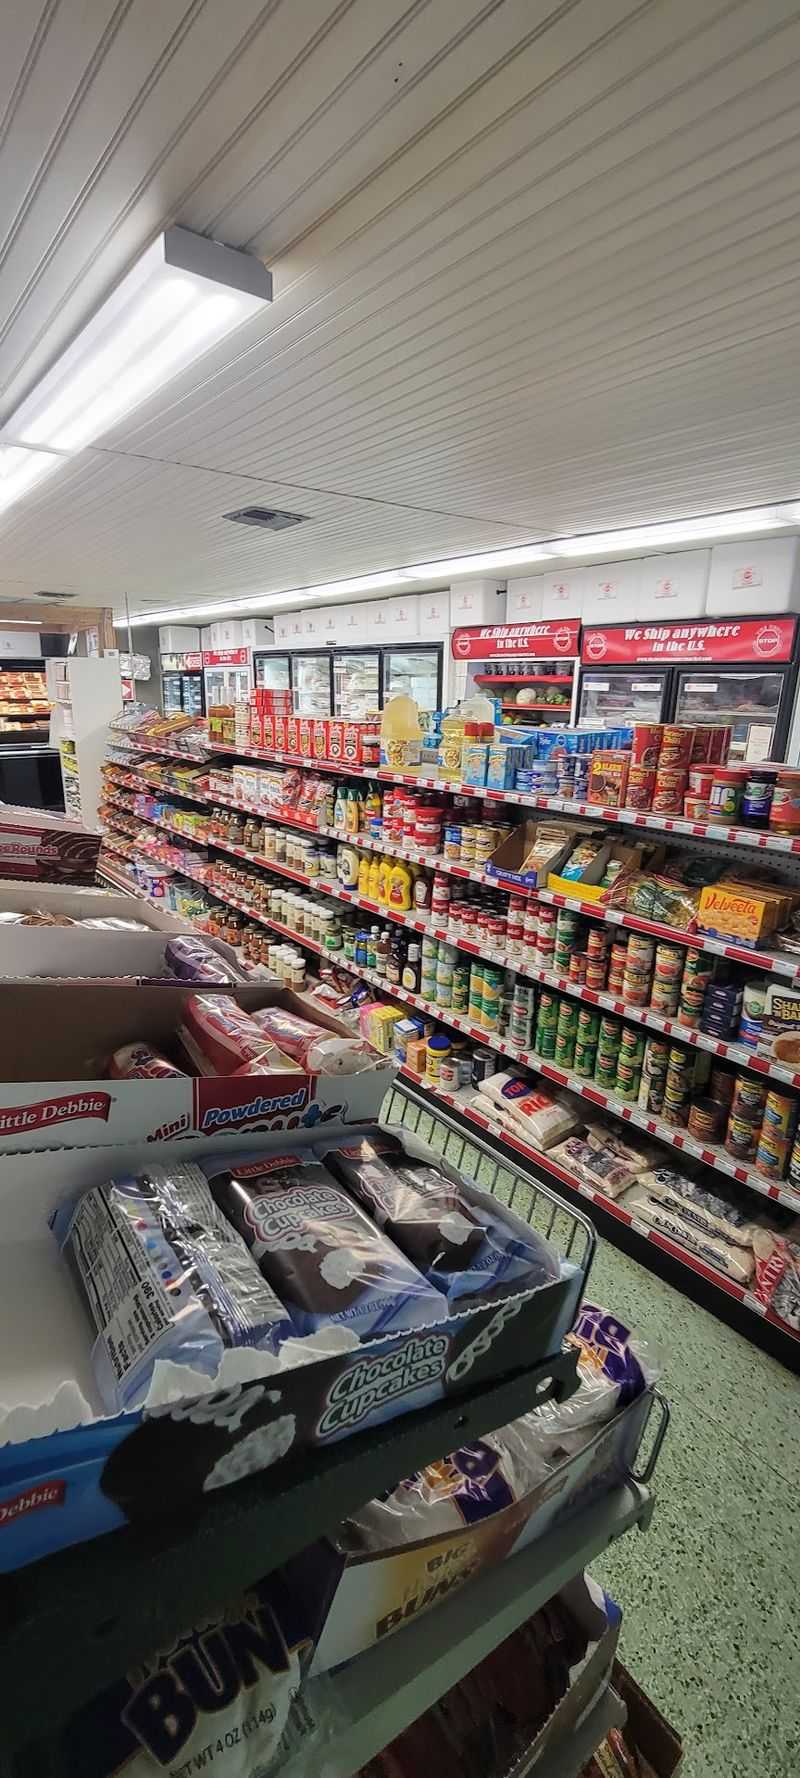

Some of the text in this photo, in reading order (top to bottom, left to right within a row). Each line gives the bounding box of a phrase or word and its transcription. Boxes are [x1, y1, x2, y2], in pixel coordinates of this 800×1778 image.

[624, 629, 642, 640] We
[643, 627, 670, 642] Ship
[671, 624, 741, 640] anywhere
[653, 641, 665, 652] in
[666, 641, 686, 652] the
[704, 892, 756, 914] Velveeta
[0, 1099, 105, 1130] ittle Debbie
[201, 1088, 306, 1128] Powdered
[518, 1094, 549, 1117] RIC
[253, 1187, 335, 1220] Chocolate
[262, 1202, 352, 1236] Cupcakes
[332, 1337, 446, 1401] Chocolate
[320, 1359, 443, 1433] Cupcakes
[121, 1600, 291, 1767] BUN
[192, 1746, 215, 1770] WT
[215, 1739, 224, 1755] 4
[224, 1727, 241, 1747] OZ
